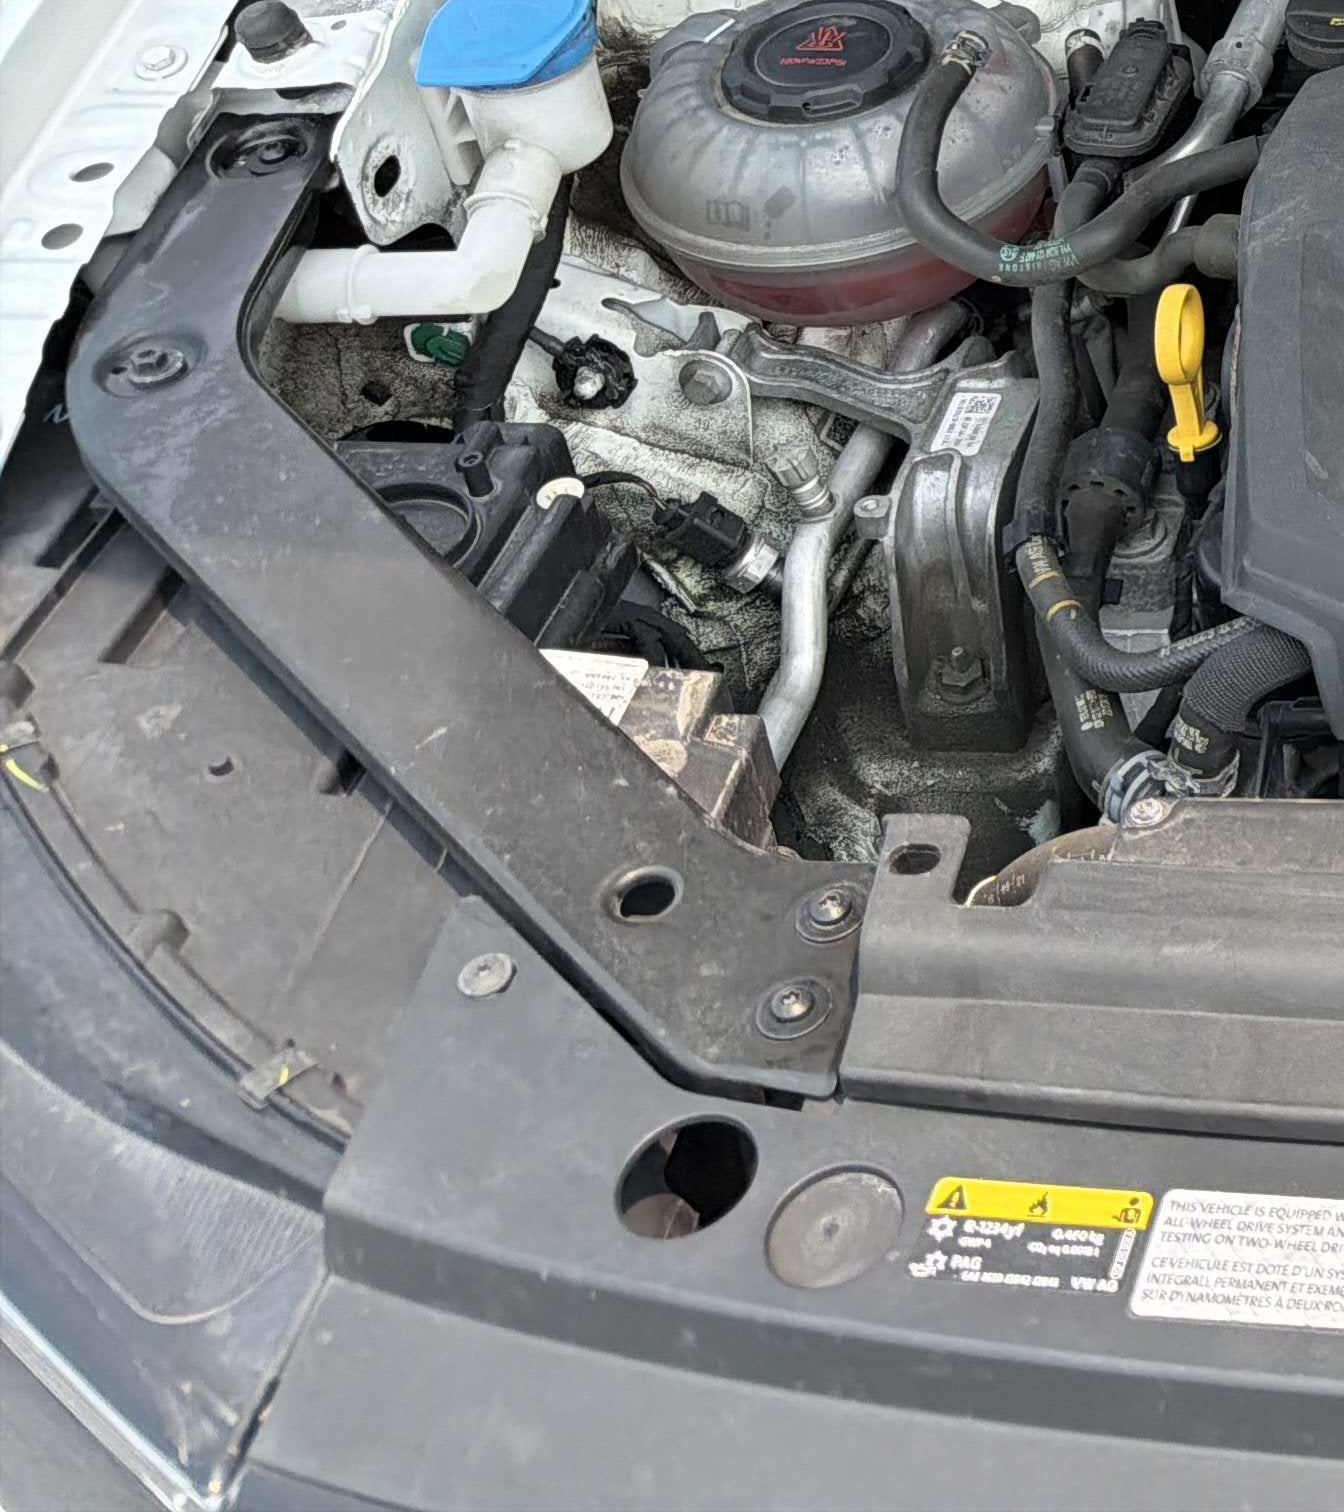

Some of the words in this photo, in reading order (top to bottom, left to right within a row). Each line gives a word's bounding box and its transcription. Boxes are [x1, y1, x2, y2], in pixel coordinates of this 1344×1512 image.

[1170, 1200, 1197, 1213] THIS
[1200, 1201, 1251, 1217] VEHICLE
[1255, 1205, 1266, 1217] IS
[1268, 1206, 1332, 1222] EQUIPPED
[1164, 1216, 1234, 1232] ALL-WHEEL
[1237, 1219, 1274, 1234] DRIVE
[1277, 1223, 1324, 1238] SYSTEM
[1161, 1230, 1212, 1245] TESTING
[1215, 1234, 1236, 1246] ON
[1238, 1235, 1317, 1253] TWO-WHEEL
[950, 1254, 983, 1271] PAG
[1151, 1256, 1168, 1269] CE
[1232, 1260, 1255, 1273] EST
[1292, 1265, 1324, 1278] D'UN
[1070, 1275, 1096, 1290] VW
[1214, 1276, 1288, 1293] PERMANENT
[1291, 1282, 1304, 1294] ET
[1140, 1288, 1167, 1301] SUR
[1286, 1298, 1323, 1312] DEUX
